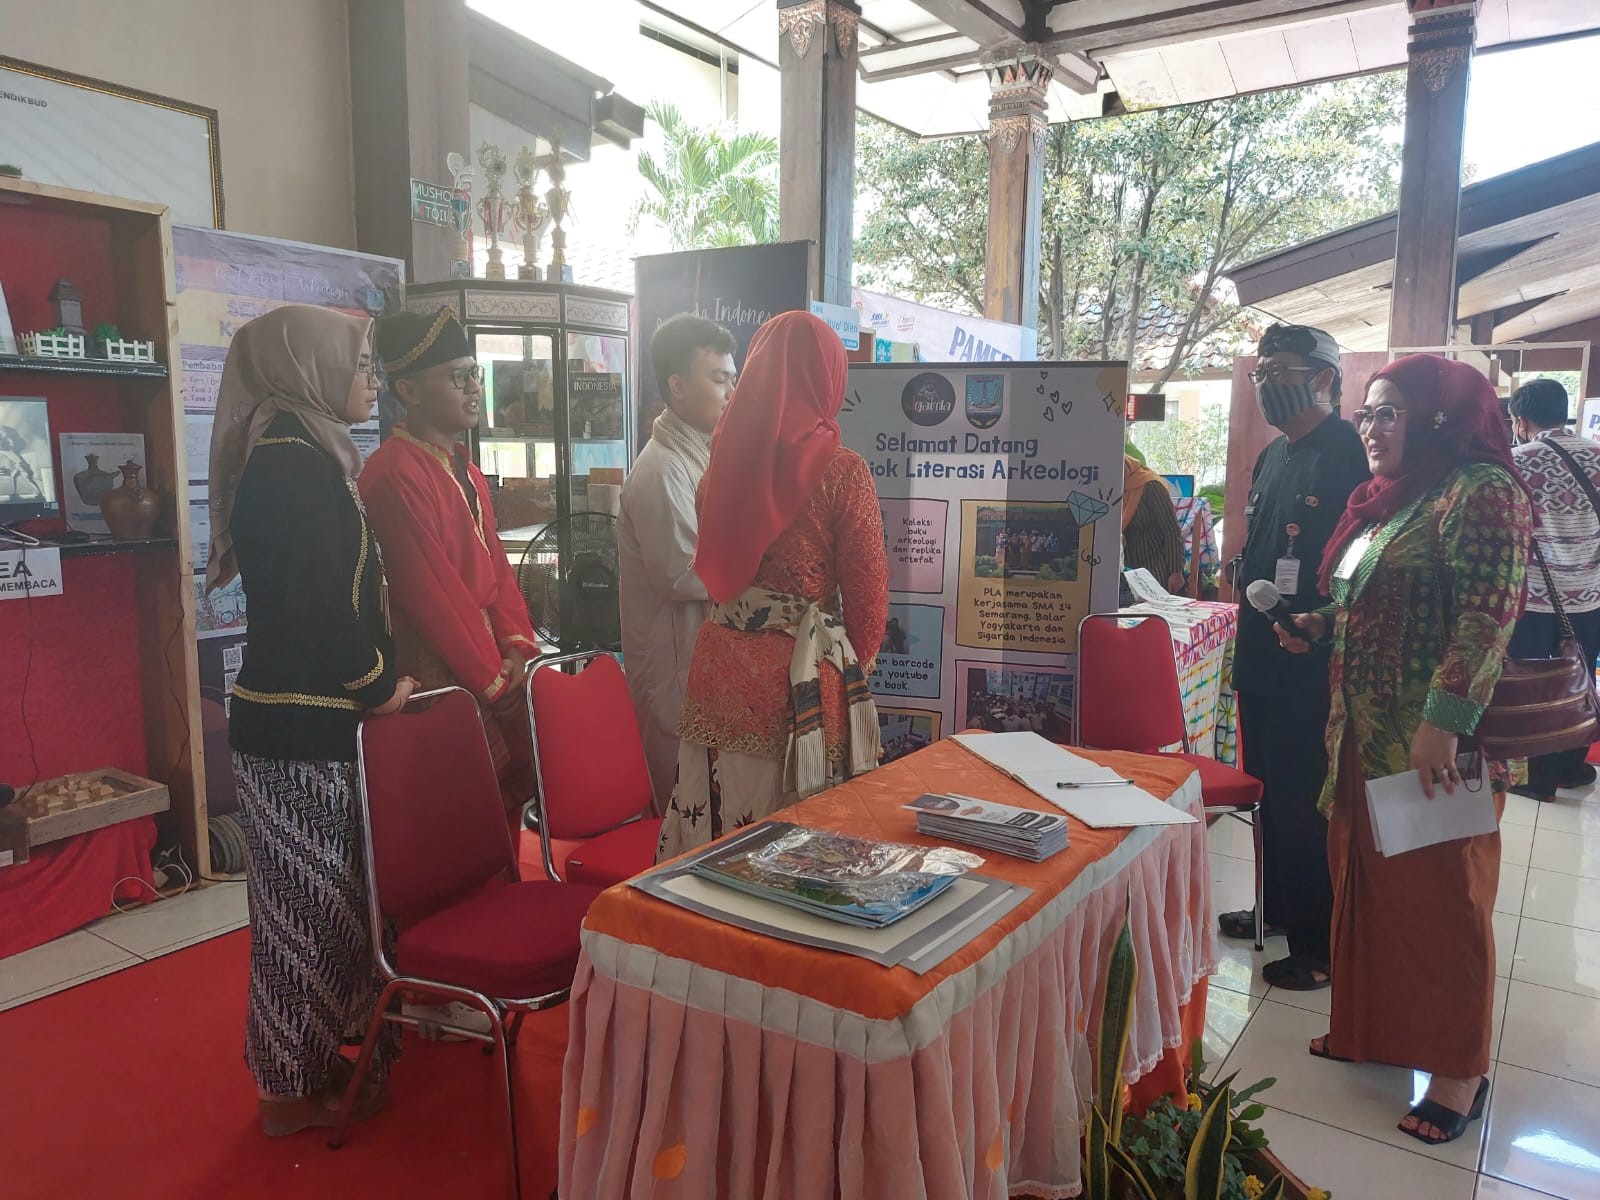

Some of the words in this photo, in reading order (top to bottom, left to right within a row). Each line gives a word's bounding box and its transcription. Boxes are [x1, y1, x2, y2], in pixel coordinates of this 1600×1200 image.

[412, 183, 452, 202] MUSHO
[574, 381, 617, 392] INDONESIA
[876, 432, 957, 453] Selamat
[965, 432, 1039, 458] Datang
[870, 458, 899, 478] jok
[906, 457, 985, 479] Literasi
[992, 459, 1100, 485] Arkeologi
[903, 518, 933, 526] Koleksi
[898, 537, 937, 546] arkeologi
[911, 546, 941, 555] replika
[899, 556, 934, 564] artefak
[0, 578, 56, 592] MEMBACA
[984, 588, 1001, 597] PLA
[1006, 590, 1062, 600] merupakan
[974, 598, 1028, 609] kerjasama
[1033, 602, 1054, 611] SMA
[1059, 603, 1072, 611] 14
[1036, 613, 1066, 622] Balar
[980, 621, 1041, 632] Yogyakarta
[1045, 624, 1064, 633] dan
[977, 632, 1015, 642] Sigarda
[1020, 634, 1066, 644] Indonesia
[892, 657, 935, 669] barcode
[888, 671, 929, 680] youtube
